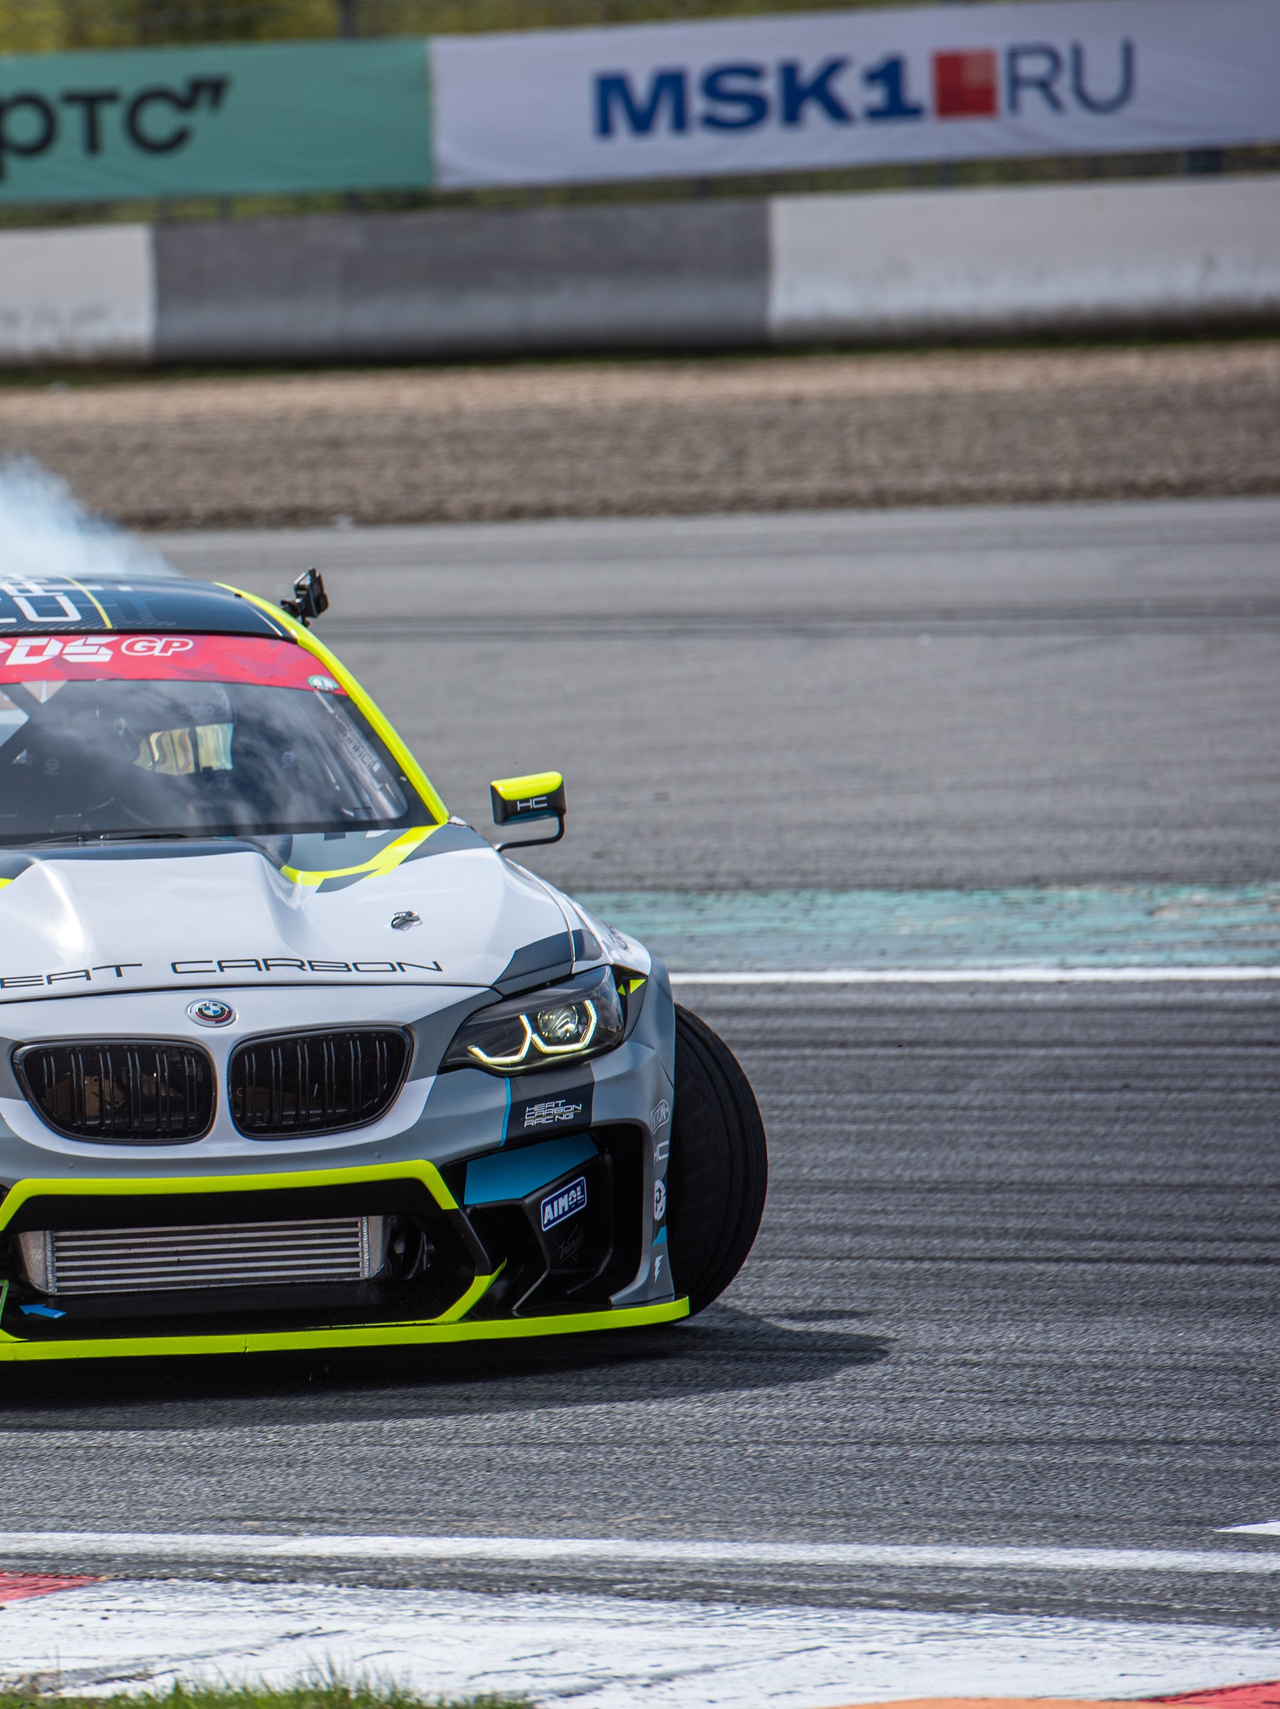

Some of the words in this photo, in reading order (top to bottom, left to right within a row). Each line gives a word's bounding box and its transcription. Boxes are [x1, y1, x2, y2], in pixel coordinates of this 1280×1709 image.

[120, 637, 193, 656] GP
[516, 796, 548, 811] HC
[171, 957, 443, 974] CARBON
[525, 1100, 566, 1113] HEAT
[525, 1103, 582, 1120] CARBON
[524, 1112, 574, 1128] RACNG
[544, 1185, 585, 1225] AIMOL
